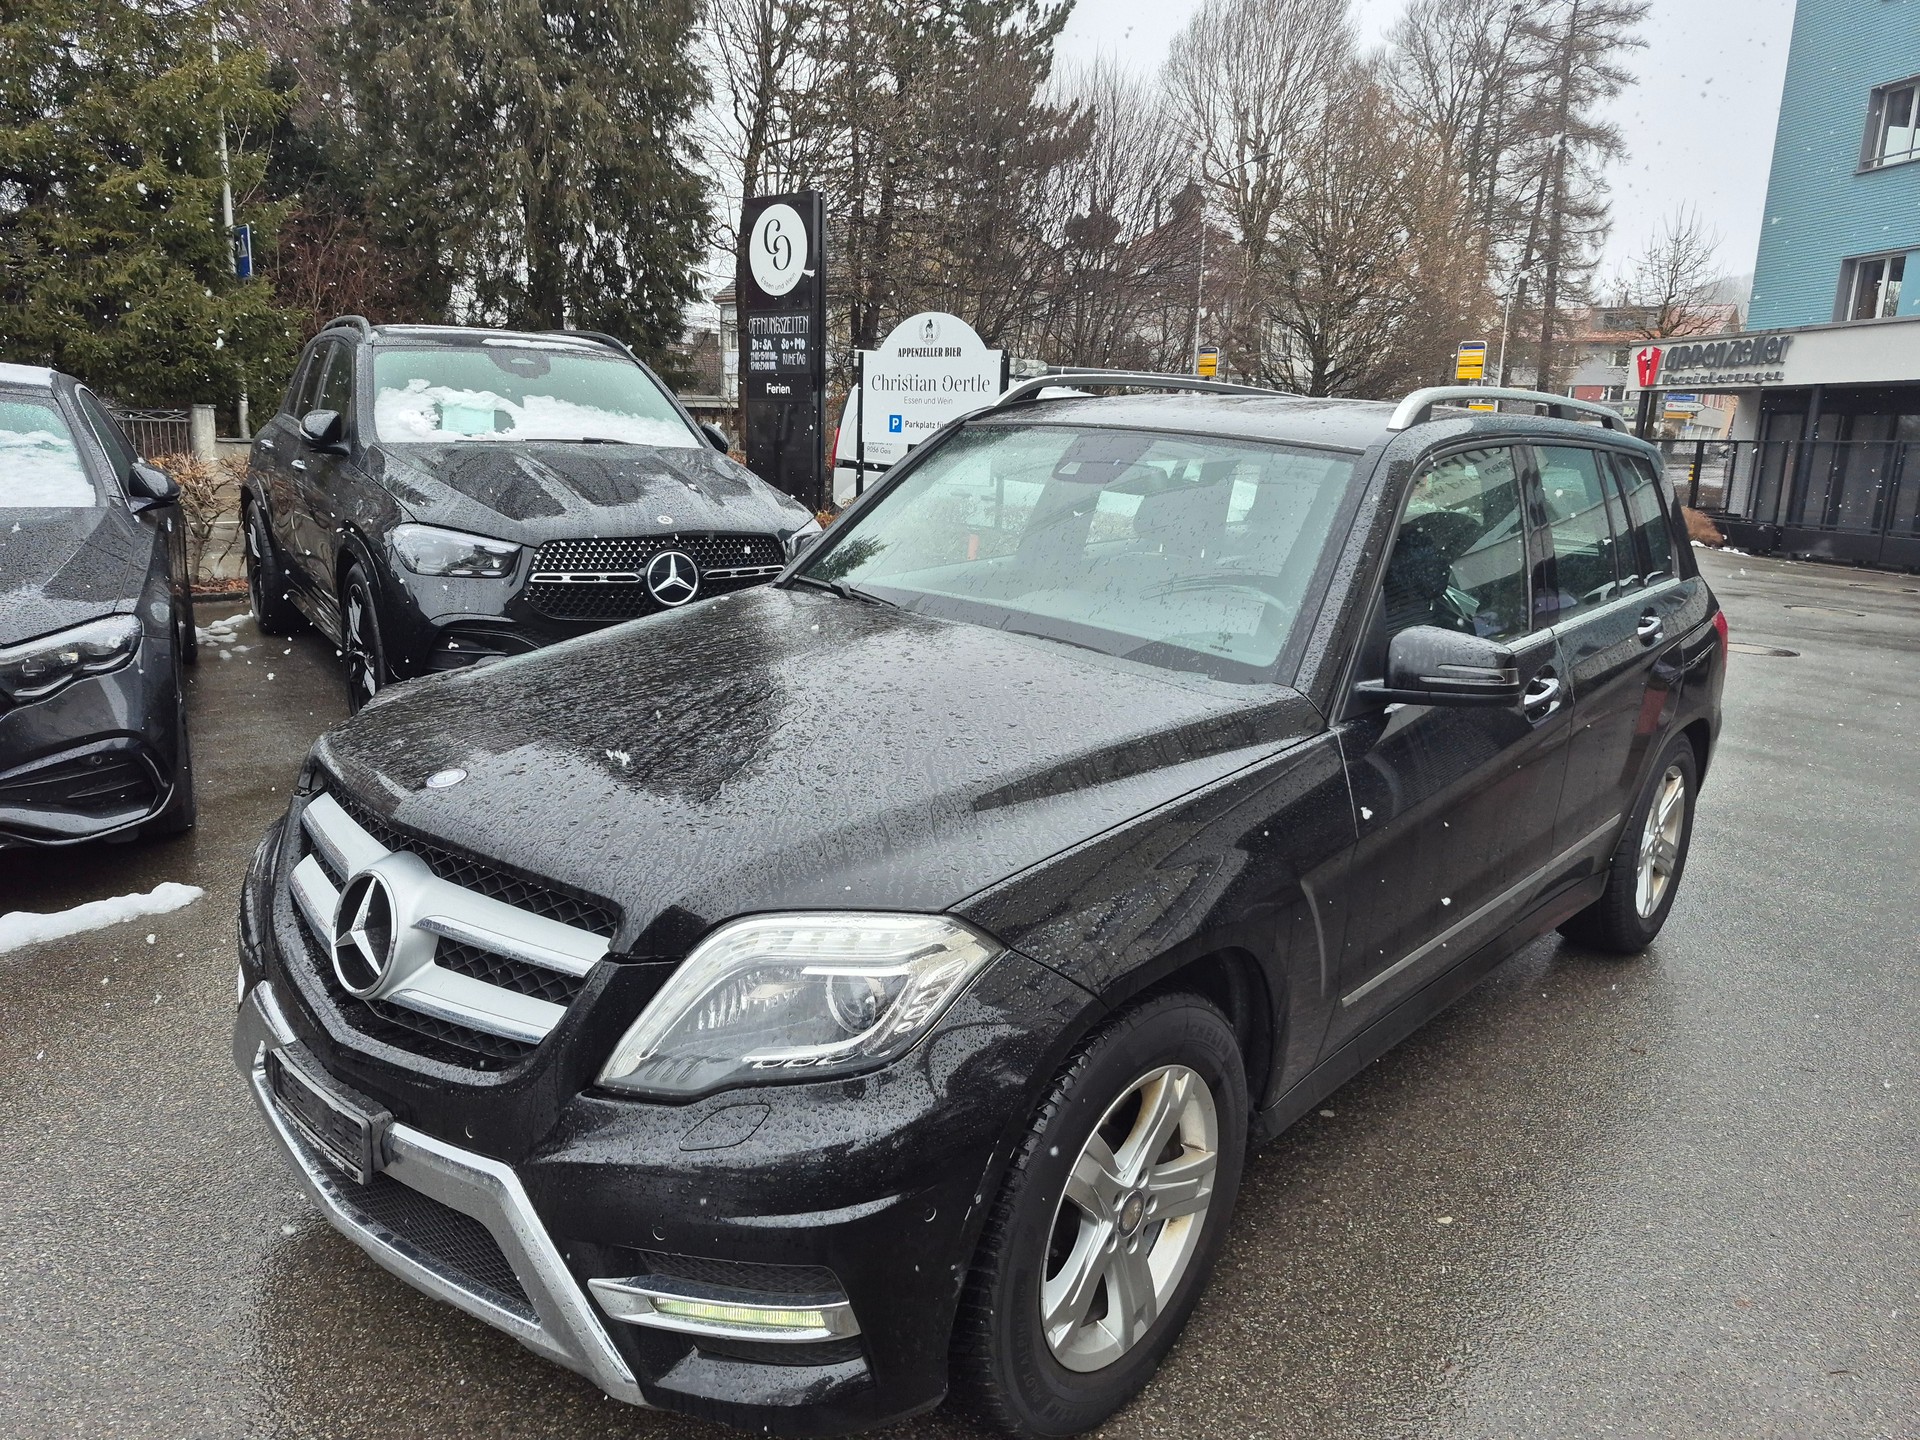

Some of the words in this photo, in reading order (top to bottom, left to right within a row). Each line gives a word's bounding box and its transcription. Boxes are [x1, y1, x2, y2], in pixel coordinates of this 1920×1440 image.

[760, 276, 774, 289] Essen
[748, 315, 808, 335] ÖFFNUNGSZEITEN
[898, 347, 943, 358] APPENZELLER
[945, 347, 961, 357] BIER
[766, 383, 790, 394] Ferien
[871, 374, 937, 391] Christian
[942, 374, 990, 392] Oertle
[904, 396, 922, 405] Essen
[924, 396, 936, 405] und
[937, 396, 953, 405] Wein
[905, 420, 935, 430] Parkplatz
